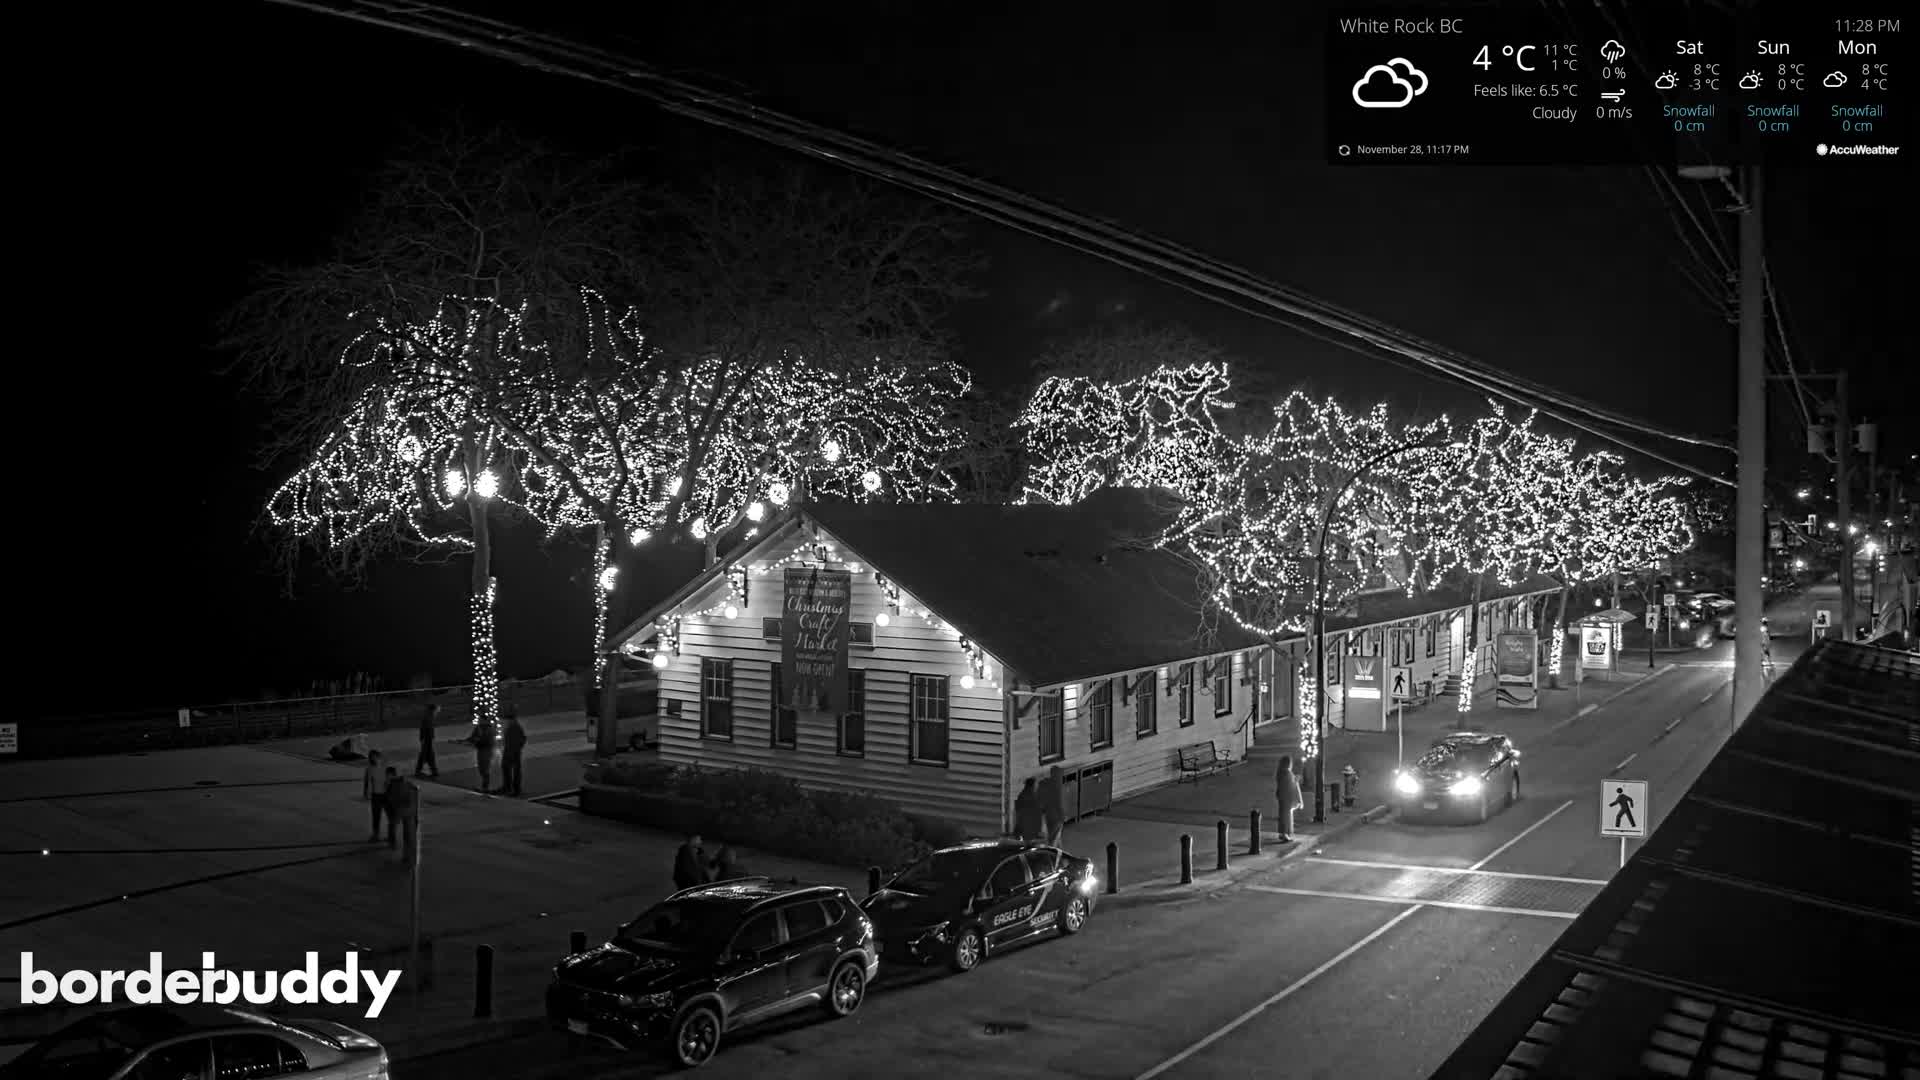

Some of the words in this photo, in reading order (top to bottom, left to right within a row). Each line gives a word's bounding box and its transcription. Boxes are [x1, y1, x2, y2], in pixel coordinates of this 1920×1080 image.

[787, 595, 844, 615] Christmas
[799, 612, 830, 638] Craft
[793, 631, 838, 651] Market
[994, 909, 1017, 925] EAGLE
[1018, 904, 1032, 918] EYE
[1030, 909, 1060, 927] SECURITY
